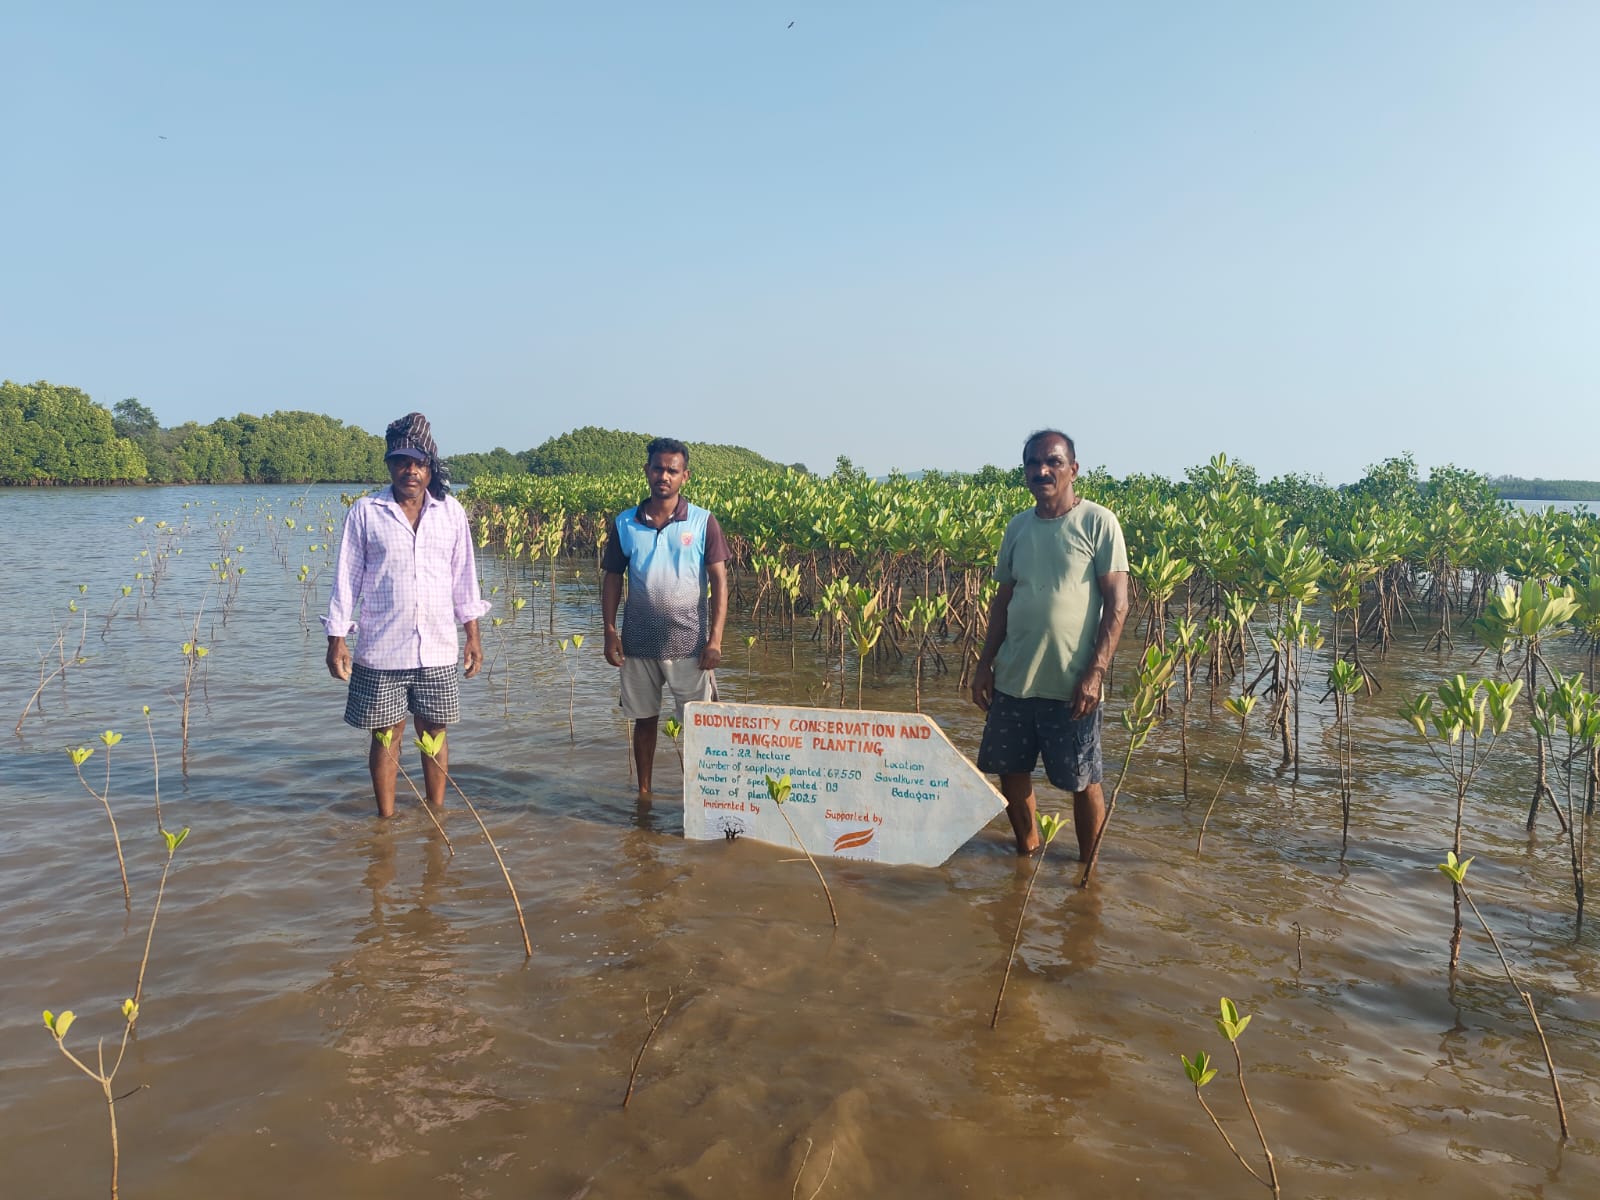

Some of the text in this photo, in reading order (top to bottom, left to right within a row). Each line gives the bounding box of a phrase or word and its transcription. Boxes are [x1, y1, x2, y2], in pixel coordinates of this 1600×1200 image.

[694, 713, 931, 740] BIODIVERSITY CONSERVATION AND
[731, 732, 884, 757] MANGROVE PLANTING
[756, 749, 791, 761] hectare
[698, 759, 730, 770] Number
[732, 761, 742, 771] of
[744, 763, 786, 778] sapplings
[884, 759, 925, 771] Location
[697, 773, 727, 783] Number
[731, 774, 742, 785] of
[929, 778, 949, 788] and
[700, 785, 720, 796] Year
[728, 786, 739, 798] of
[789, 792, 818, 804] 2025
[750, 802, 761, 815] by
[824, 808, 883, 826] Supported by
